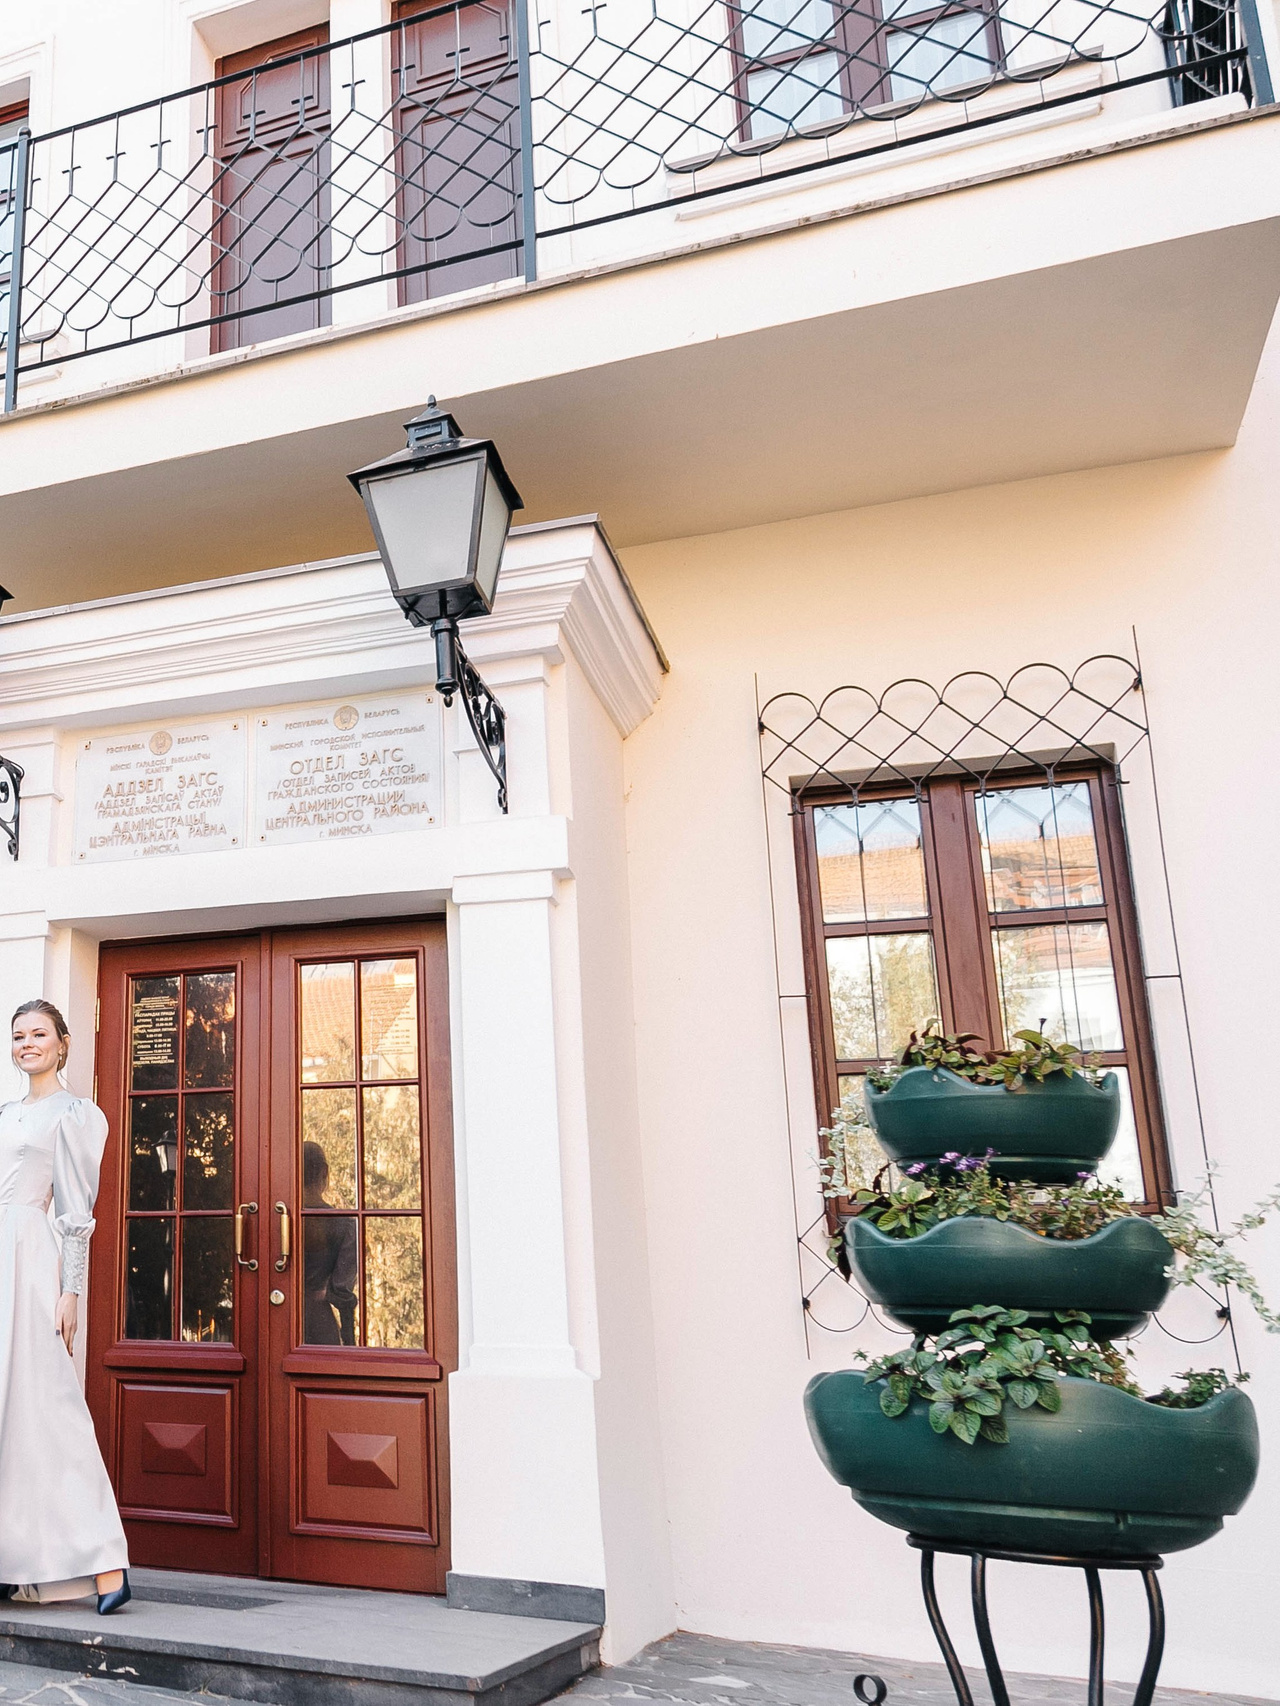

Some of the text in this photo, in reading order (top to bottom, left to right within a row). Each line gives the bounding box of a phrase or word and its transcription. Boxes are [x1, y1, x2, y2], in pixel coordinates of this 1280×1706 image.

[285, 709, 400, 730] РЕСПУБЛИКА БЕЛАРУСЬ
[177, 734, 209, 744] БЕЛАРУСЬ
[310, 734, 355, 746] ГОРОДСКОЙ
[290, 748, 404, 774] ОТДЕЛ ЗАГС
[325, 769, 369, 783] ЗАПИСЕЙ
[380, 764, 415, 777] АКТОВ
[103, 772, 218, 798] АДДЗЕЛ ЗАГС
[146, 792, 185, 804] ЗАПІСАЎ
[194, 785, 224, 800] АКТАЎ
[268, 783, 354, 800] ГРАЖДАНСКОГО
[97, 802, 182, 819] ГРАМАДЗЯНСКАГА
[287, 790, 405, 814] АДМИНИСТРАЦИИ
[112, 812, 206, 834] АДМІНІСТРАЦЫІ
[265, 801, 429, 830] ЦЕНТРАЛЬНОГО РАЙОНА
[89, 823, 227, 849] ЦЭНТРАЛЬНАГА РАЁНА
[329, 824, 372, 837] МИНСКА
[143, 844, 180, 856] МІНСКА
